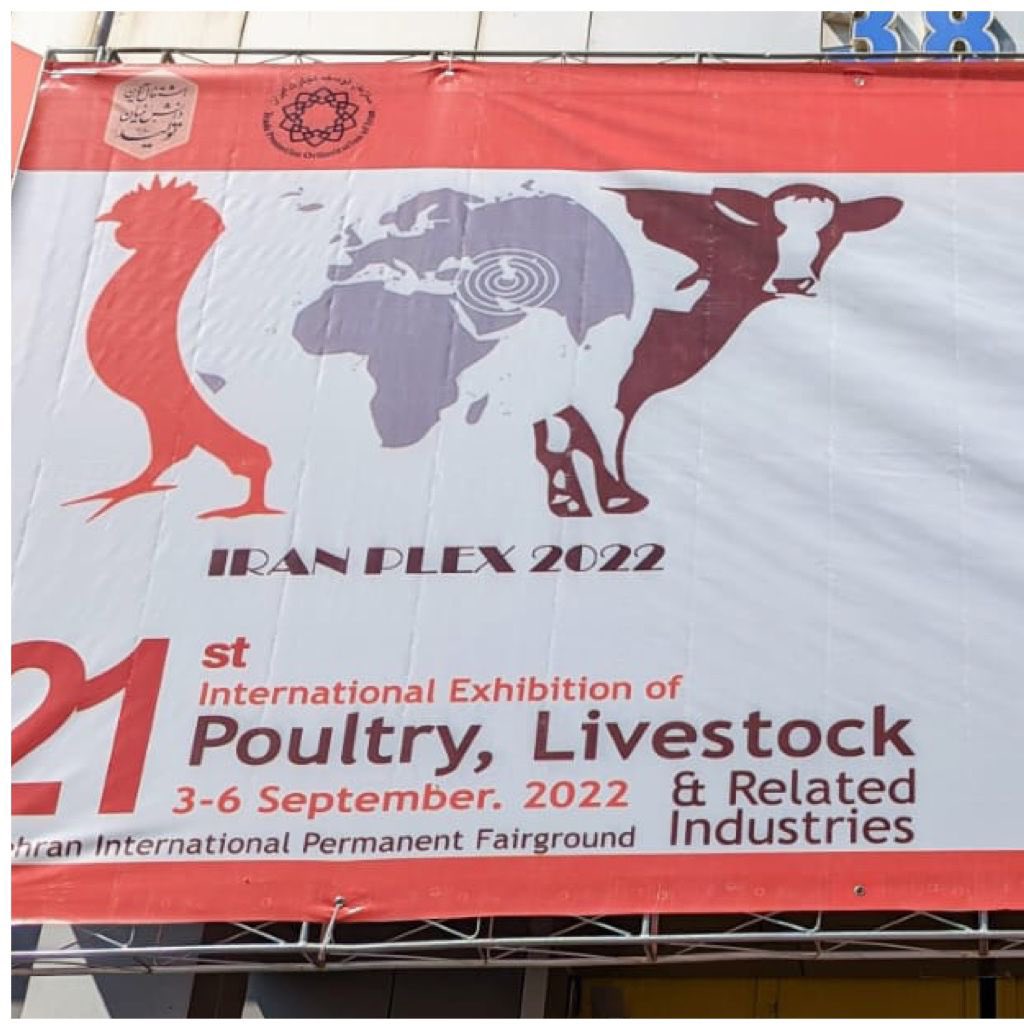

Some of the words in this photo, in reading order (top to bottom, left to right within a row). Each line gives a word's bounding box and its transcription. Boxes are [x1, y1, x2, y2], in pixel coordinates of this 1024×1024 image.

[208, 549, 351, 578] IRAN
[365, 547, 516, 576] PLEX
[531, 544, 667, 574] 2022
[204, 637, 251, 671] st
[200, 681, 437, 707] International
[449, 678, 634, 705] Exhibition
[646, 675, 683, 701] of
[11, 637, 171, 818] 21
[190, 712, 494, 778] Poultry,
[534, 705, 916, 762] Livestock
[174, 787, 243, 816] 3-6
[257, 785, 502, 821] September.
[526, 780, 629, 812] 2022
[672, 771, 707, 808] &
[729, 768, 917, 807] Related
[97, 832, 291, 856] International
[303, 832, 464, 855] Permanent
[477, 827, 637, 856] Fairground
[670, 808, 916, 847] Industries
